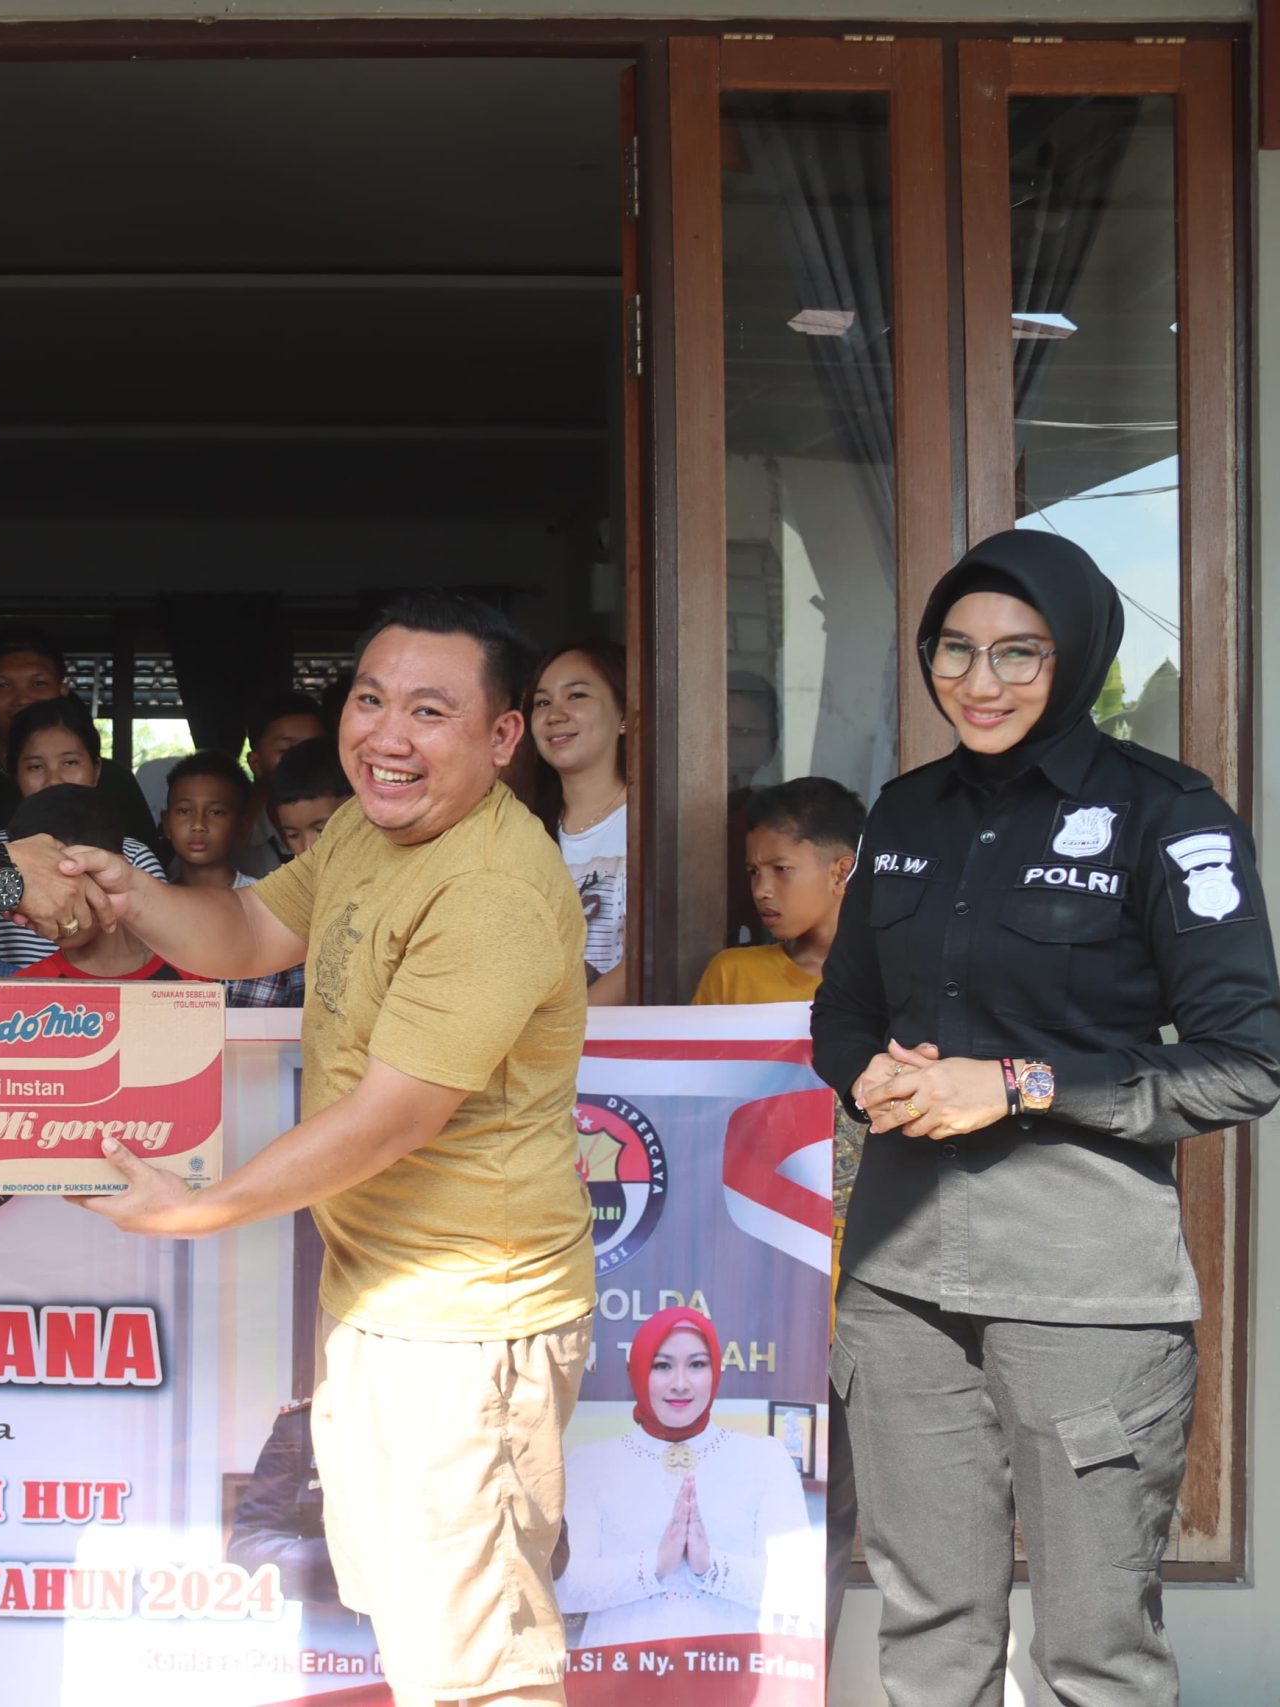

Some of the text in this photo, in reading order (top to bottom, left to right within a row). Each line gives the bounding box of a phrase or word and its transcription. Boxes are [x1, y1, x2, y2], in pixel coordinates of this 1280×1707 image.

[1024, 867, 1119, 895] POLRI
[152, 990, 184, 999] GUNAKAN
[186, 990, 216, 999] SEBELUM
[7, 1078, 65, 1096] Instan
[37, 1119, 173, 1149] goreng
[607, 1098, 663, 1194] DIPERCAYA
[595, 1288, 712, 1321] OLDA
[22, 1480, 128, 1521] HUT
[145, 1569, 277, 1612] 2024
[301, 1652, 364, 1673] Erlan
[612, 1652, 628, 1671] &
[639, 1652, 674, 1676] Ny.
[684, 1651, 739, 1672] Titin
[749, 1653, 815, 1680] Erlan
